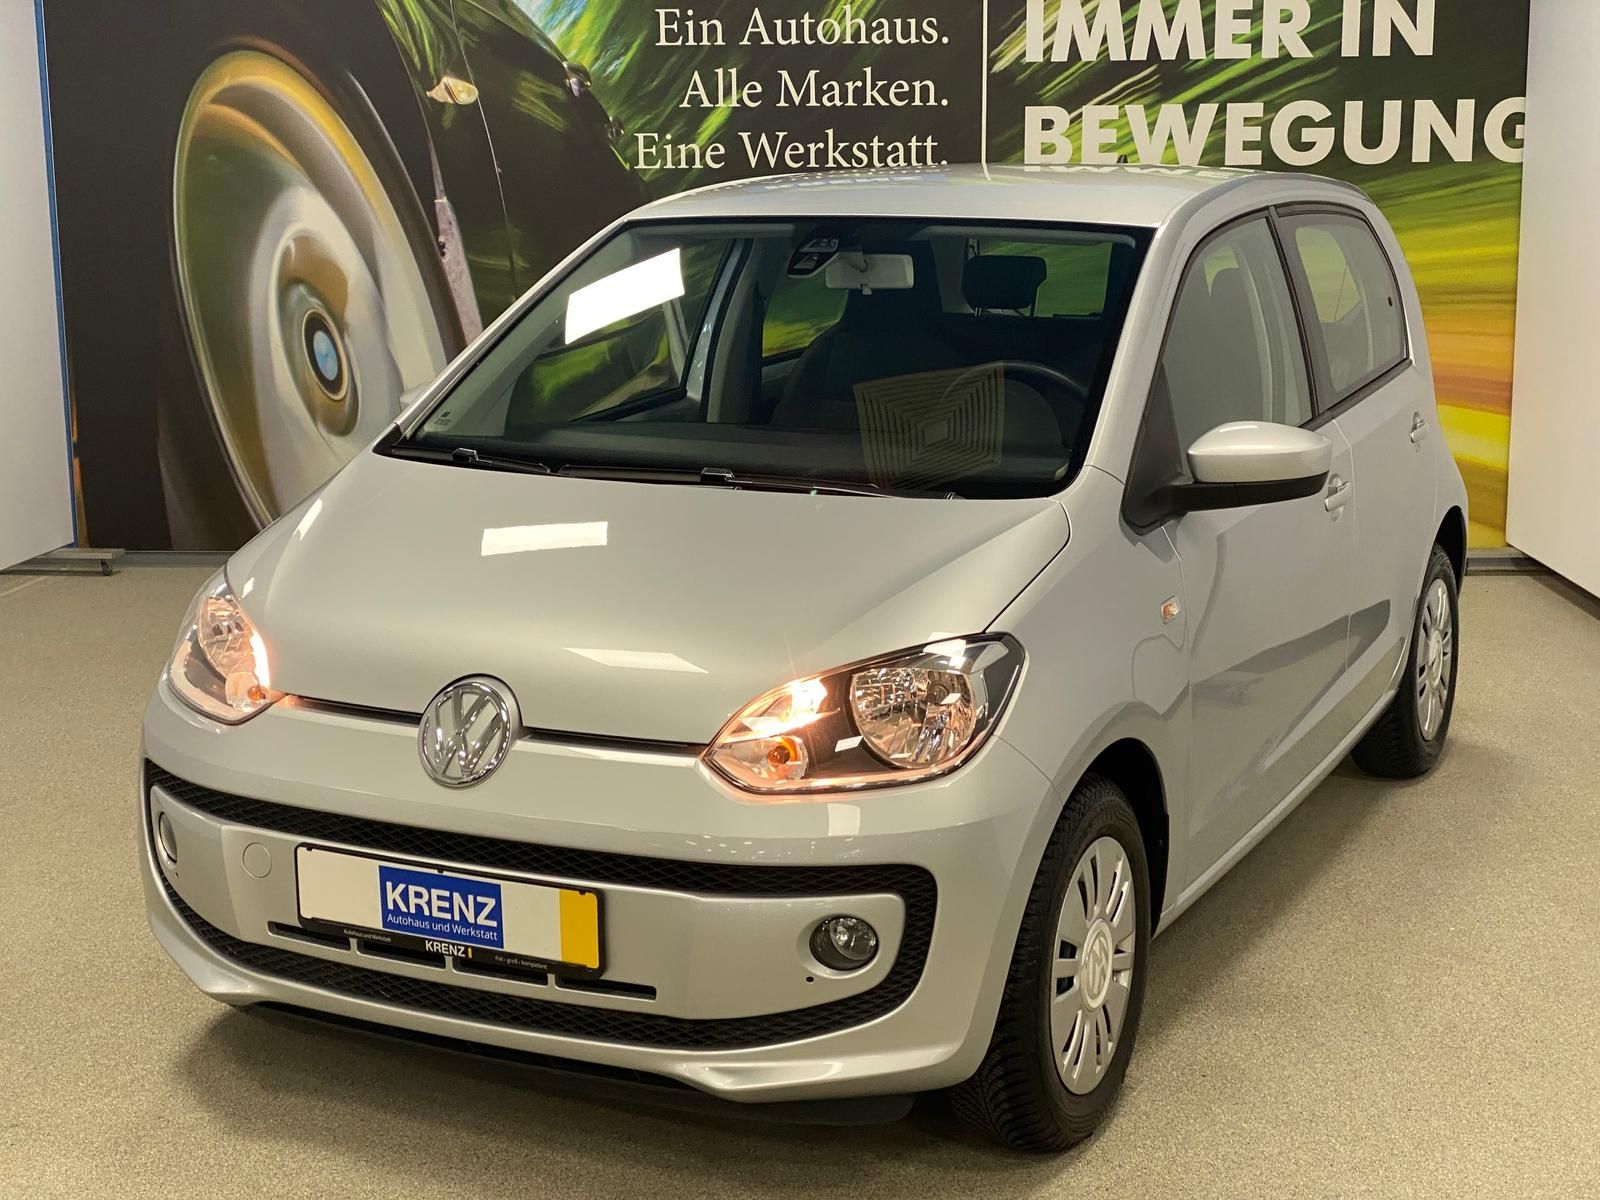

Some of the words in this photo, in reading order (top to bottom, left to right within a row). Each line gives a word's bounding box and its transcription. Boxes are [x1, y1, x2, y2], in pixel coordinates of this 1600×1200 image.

[654, 8, 725, 46] Ein
[739, 5, 949, 46] Autohaus.
[1024, 0, 1312, 62] IMMER
[1340, 0, 1436, 57] IN
[679, 67, 762, 108] Alle
[776, 66, 949, 107] Marken.
[633, 131, 726, 169] Eine
[738, 128, 948, 169] Werkstatt.
[1023, 97, 1527, 167] BEWEGUNG
[385, 881, 498, 928] KRENZ
[387, 913, 430, 929] Autohaus
[431, 920, 450, 933] und
[451, 924, 498, 941] Werkstatt
[425, 940, 466, 958] KRENZ
